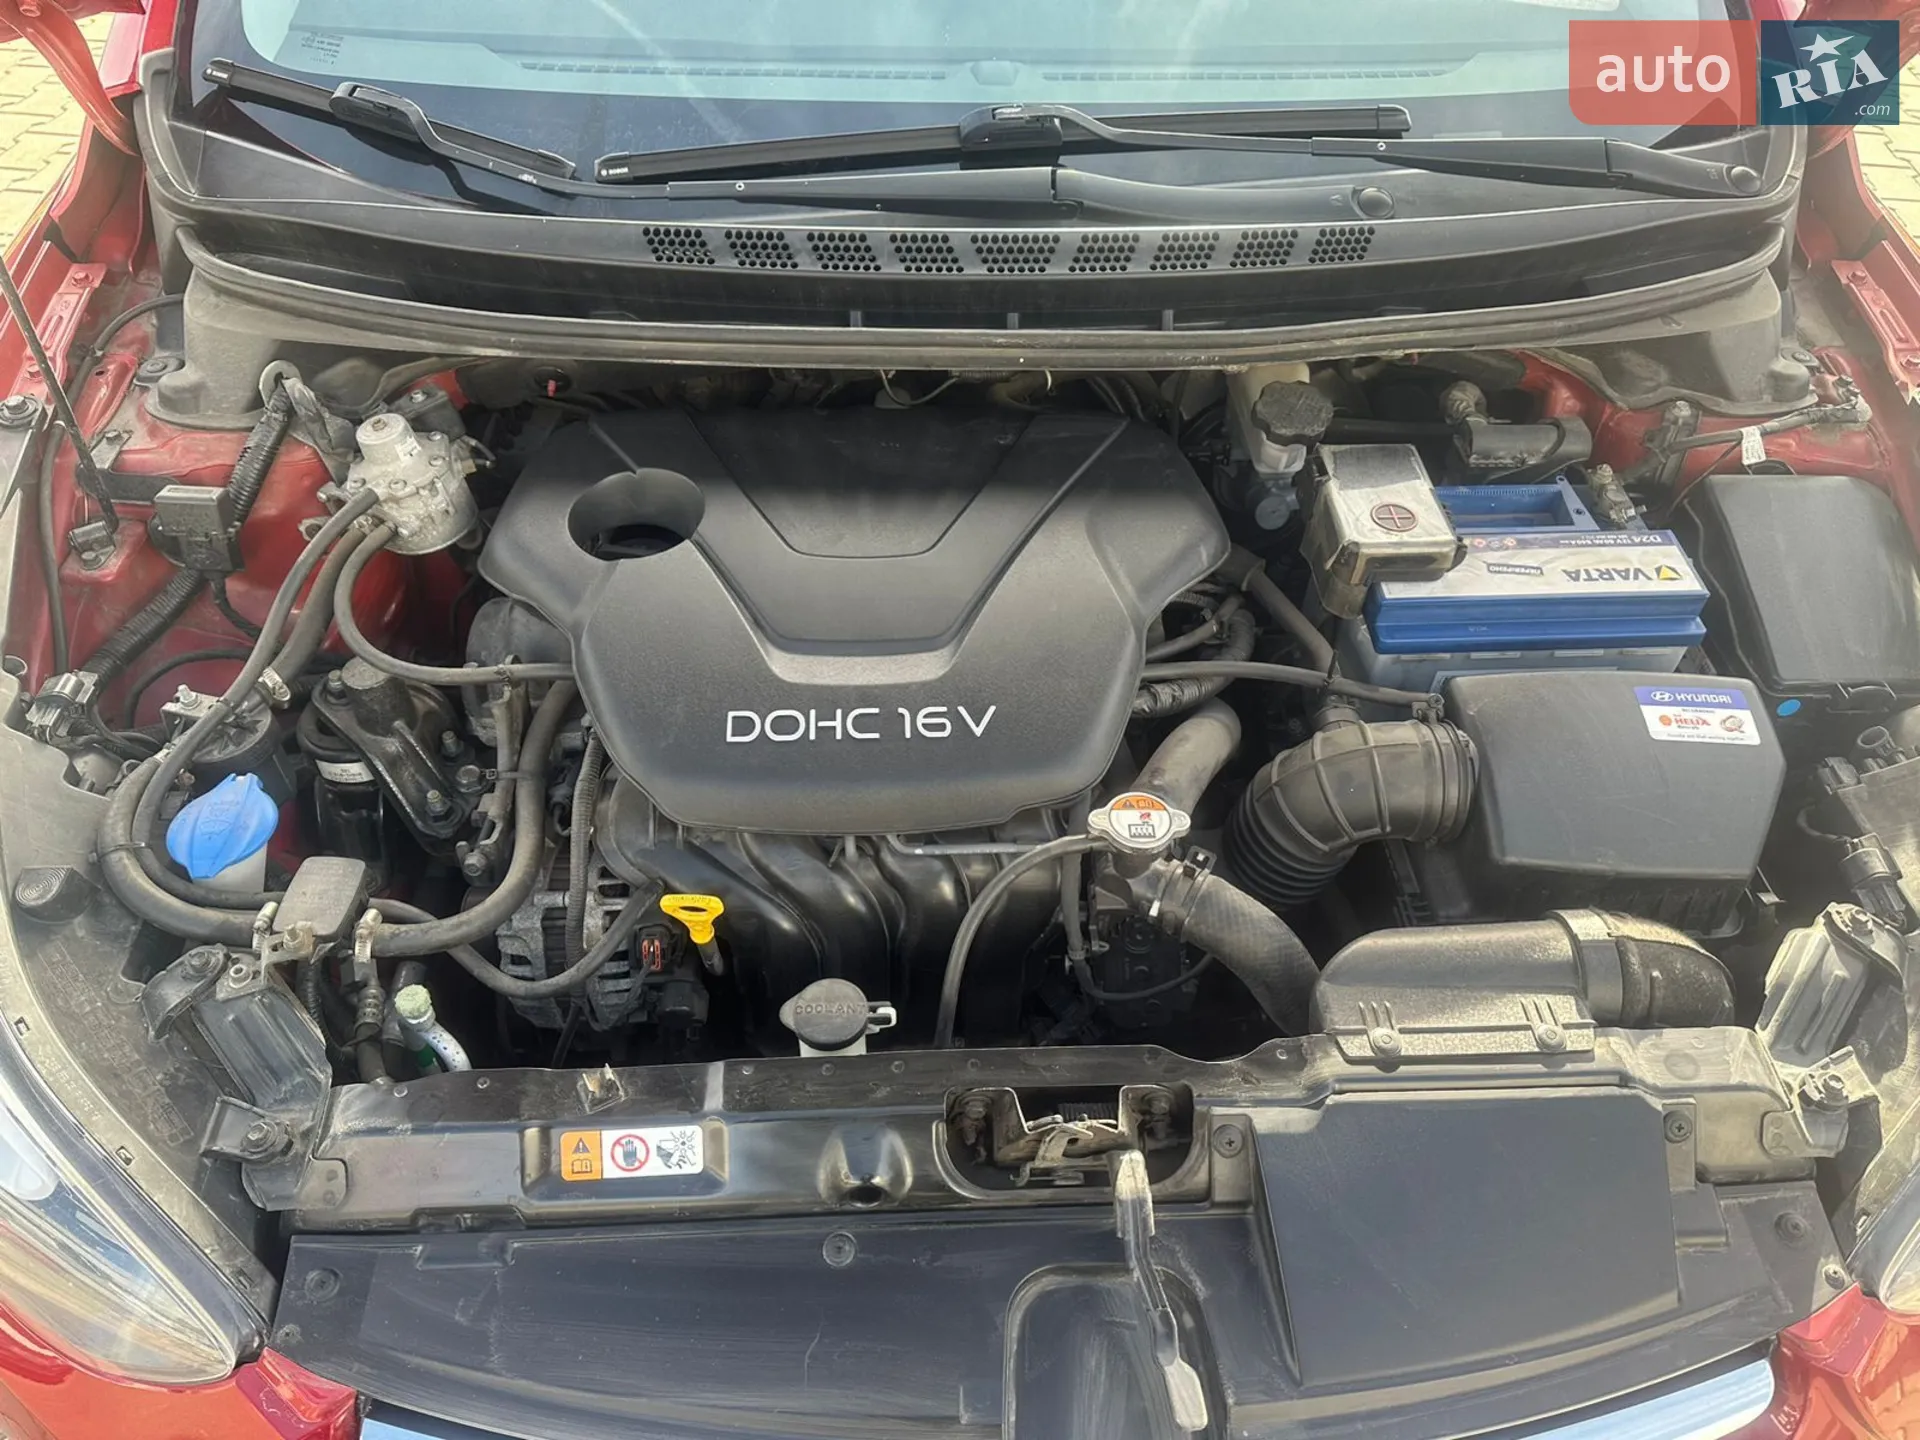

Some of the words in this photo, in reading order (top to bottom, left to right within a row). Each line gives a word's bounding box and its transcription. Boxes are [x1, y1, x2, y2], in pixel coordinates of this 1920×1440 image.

[1561, 567, 1653, 582] VARTA
[1675, 692, 1732, 704] HYUNDAI
[726, 707, 880, 743] DOHC
[898, 705, 997, 739] 16V
[794, 1002, 866, 1016] COOLANT
